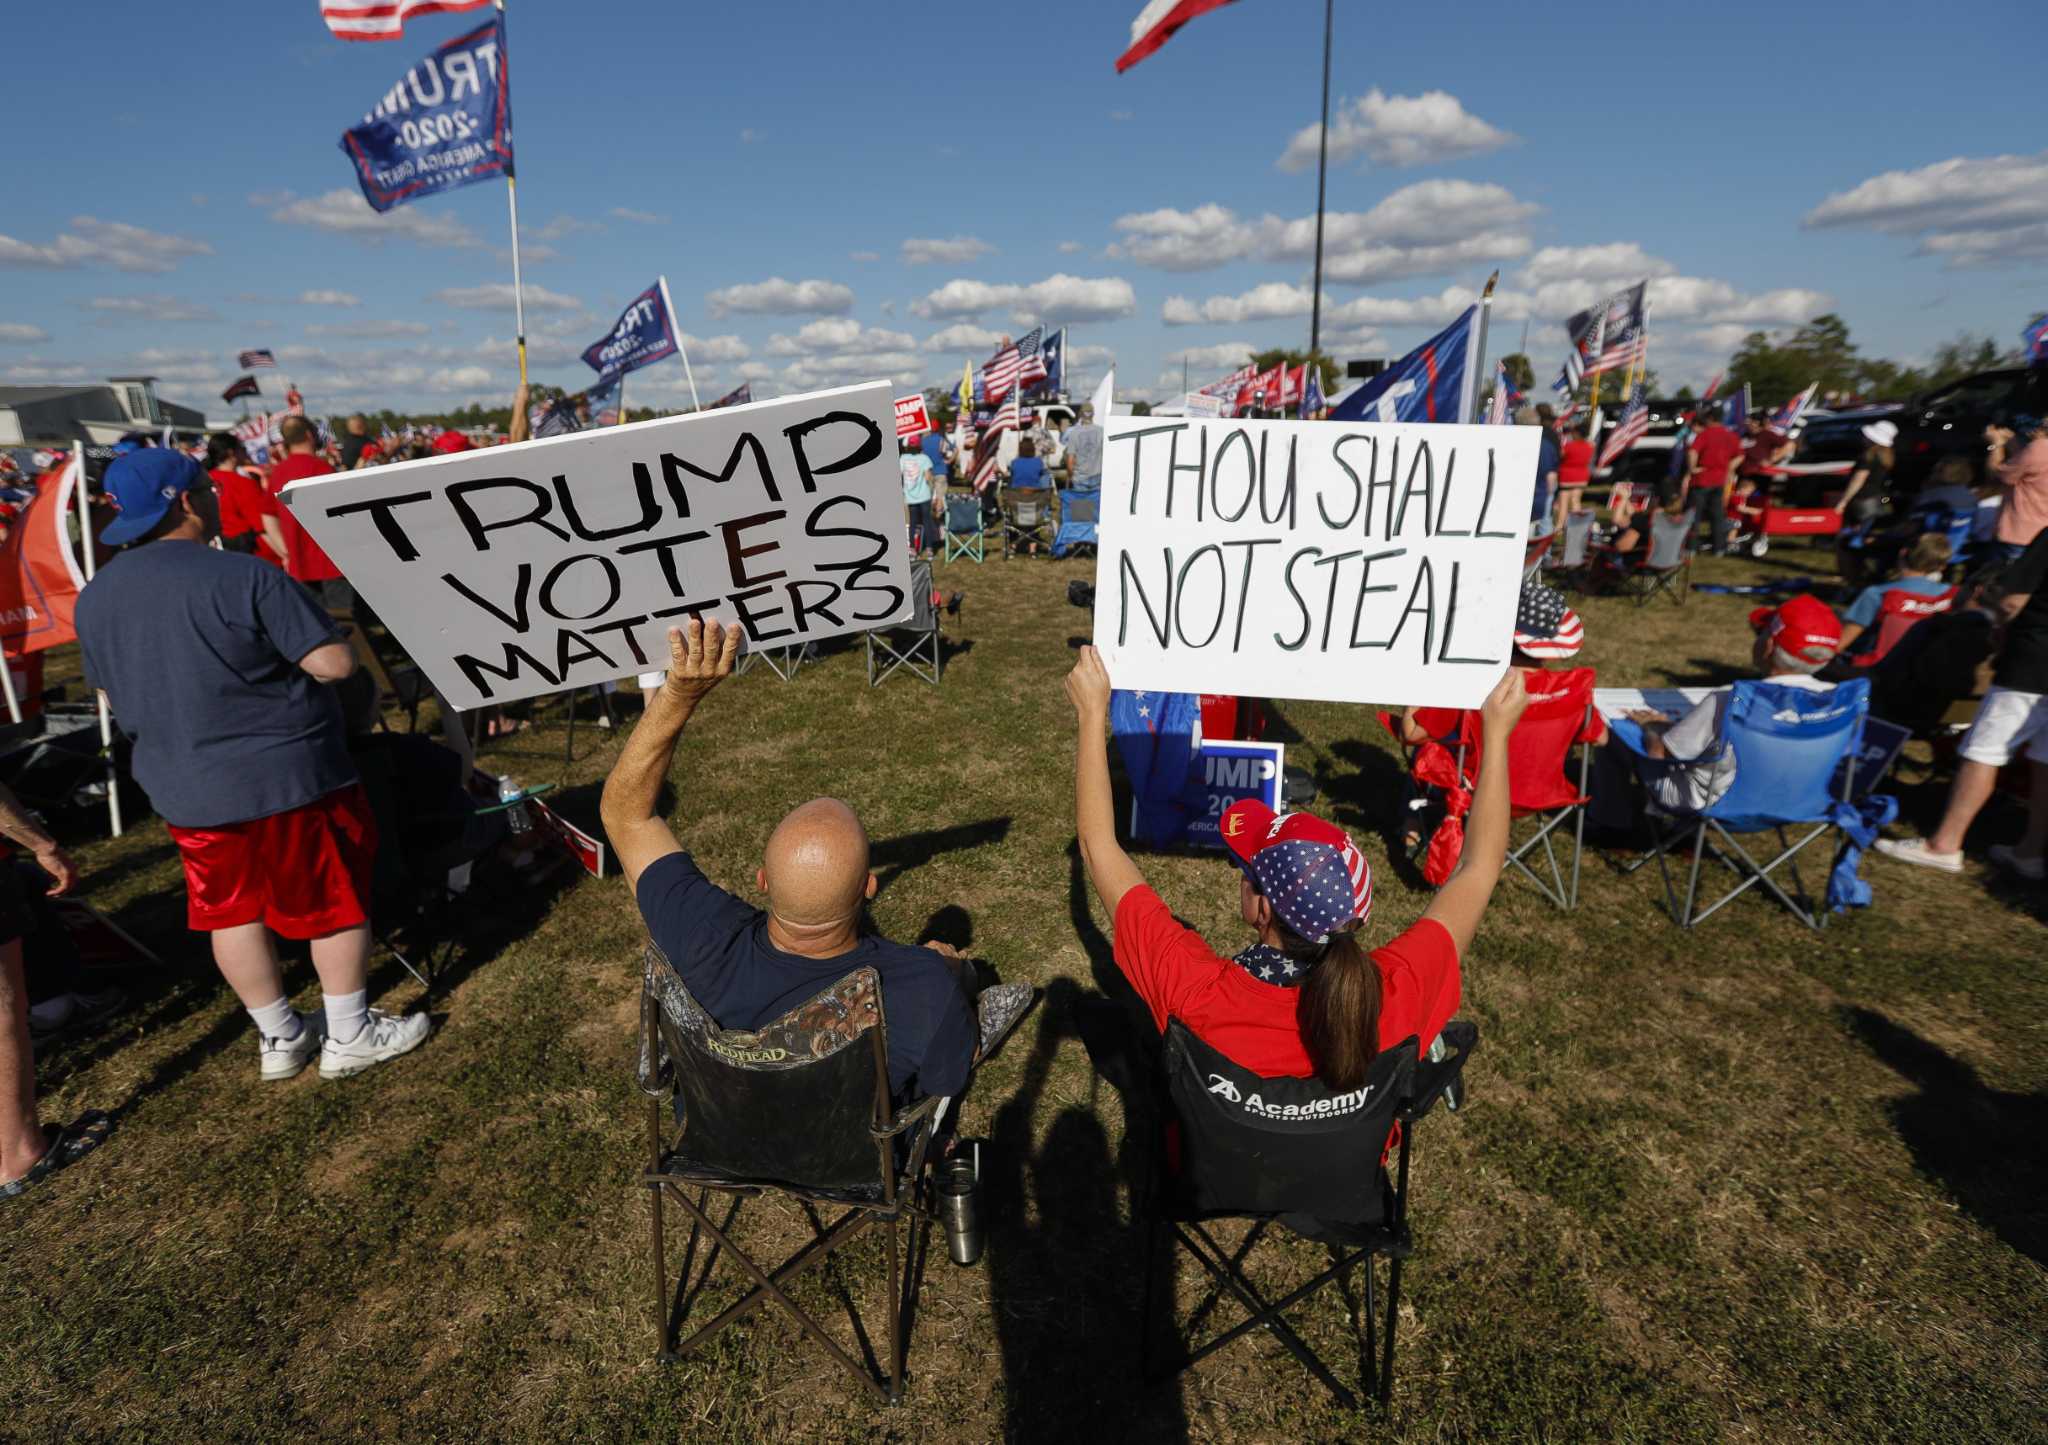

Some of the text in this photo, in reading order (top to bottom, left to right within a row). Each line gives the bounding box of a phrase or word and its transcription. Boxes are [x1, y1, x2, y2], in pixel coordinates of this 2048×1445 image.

[325, 410, 883, 562] TRUMP
[1108, 423, 1516, 542] THOU SHALL
[441, 495, 889, 634] VOTES
[1118, 538, 1500, 666] NOT STEAL
[454, 564, 905, 699] MATTERS
[1245, 1086, 1369, 1116] Academy
